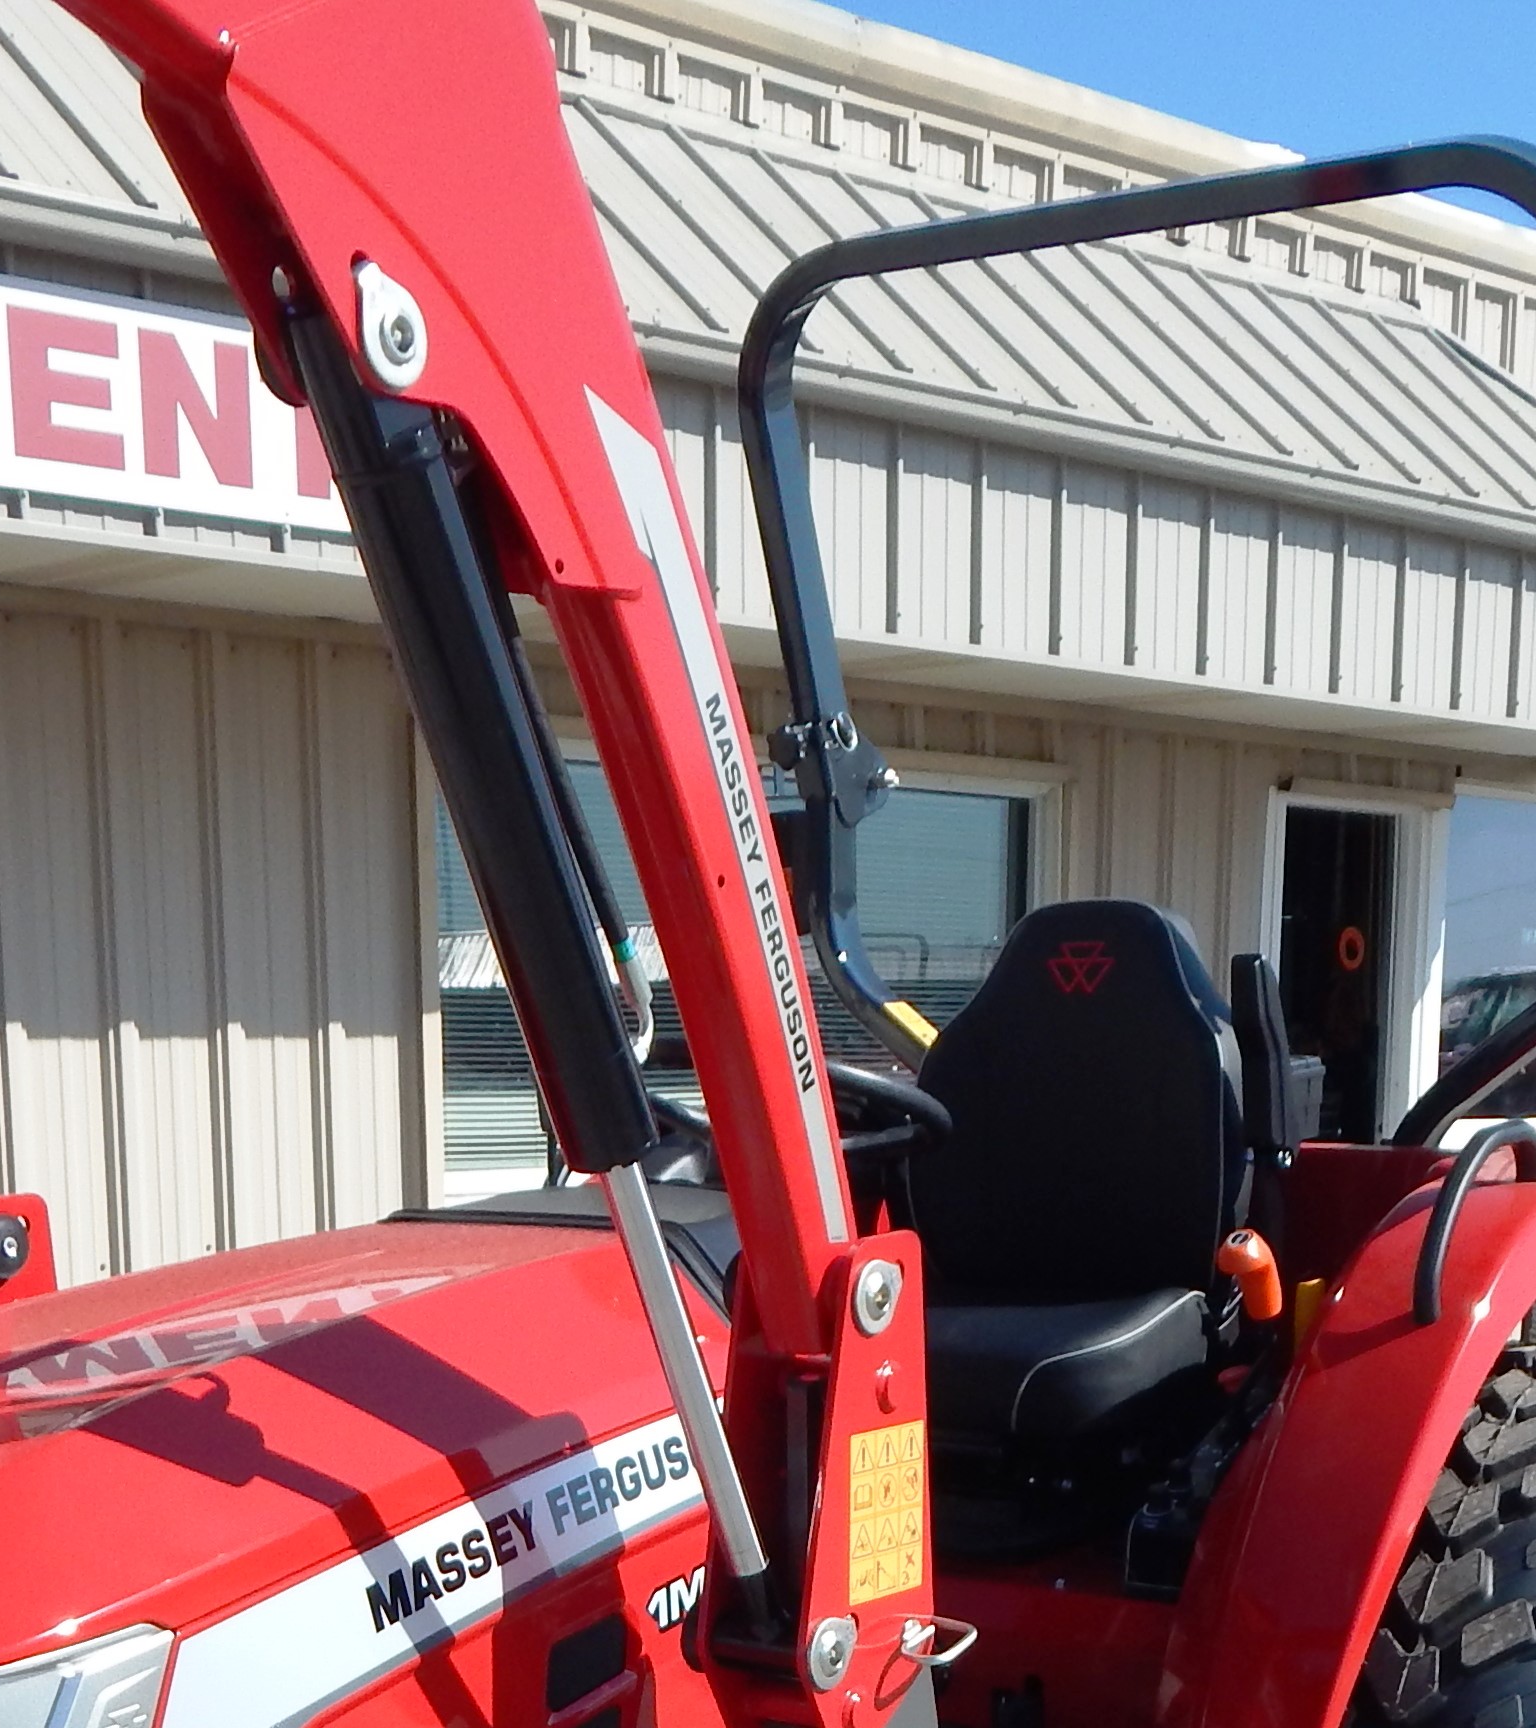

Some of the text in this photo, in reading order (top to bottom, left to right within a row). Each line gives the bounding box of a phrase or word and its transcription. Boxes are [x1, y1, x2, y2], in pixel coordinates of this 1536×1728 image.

[705, 692, 815, 1093] MASSEY FERGUSON
[365, 1498, 534, 1633] MASSEY
